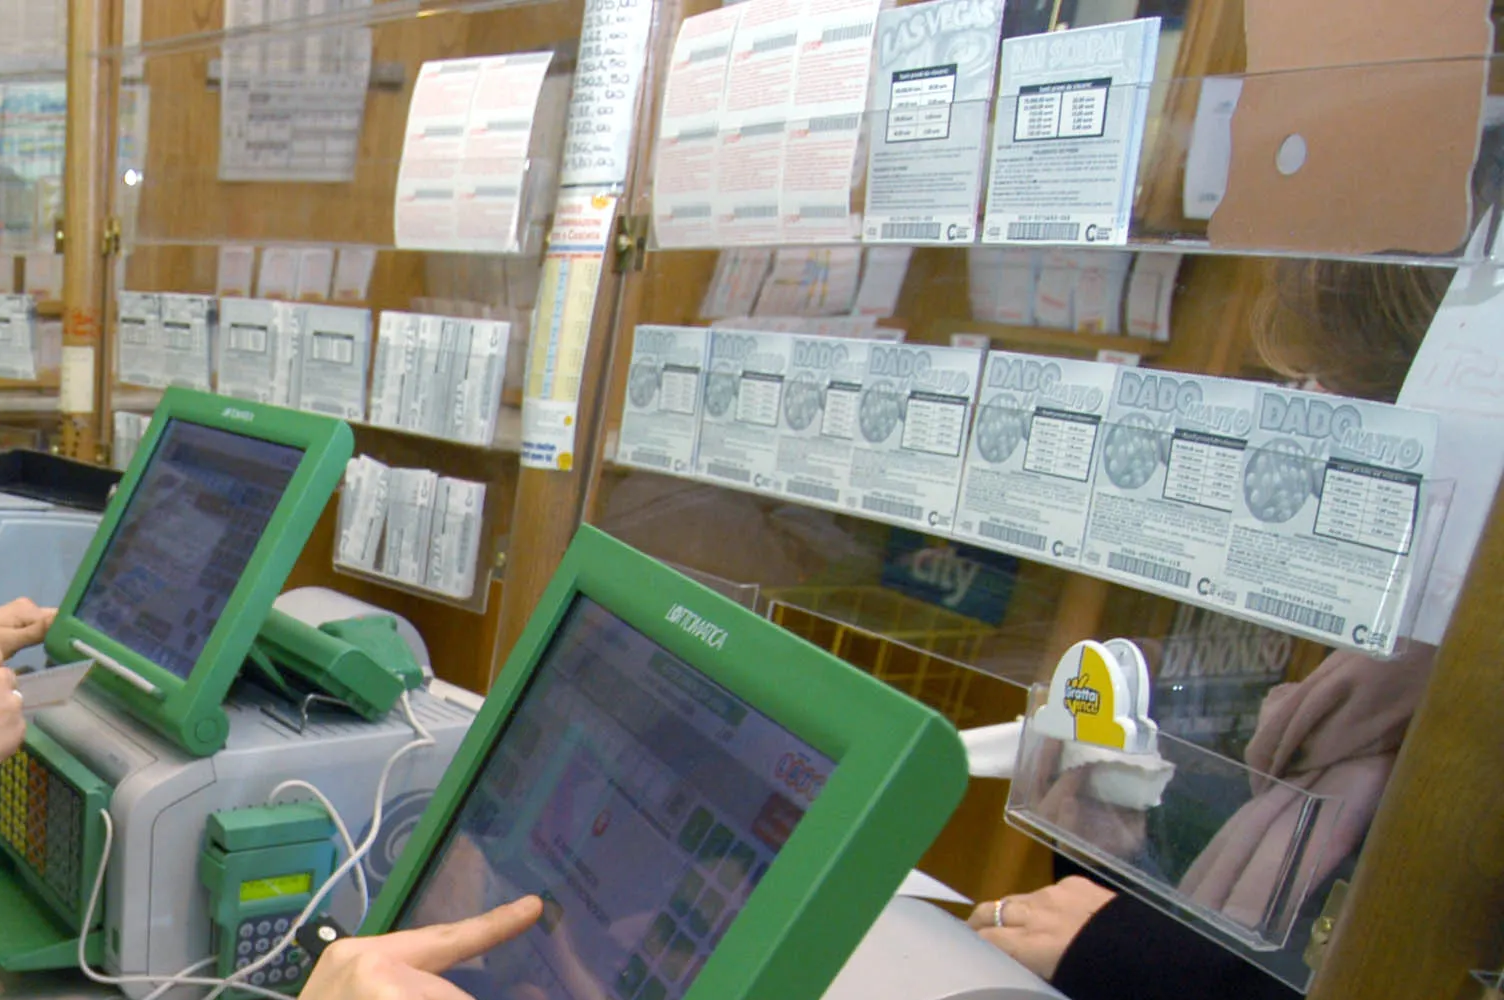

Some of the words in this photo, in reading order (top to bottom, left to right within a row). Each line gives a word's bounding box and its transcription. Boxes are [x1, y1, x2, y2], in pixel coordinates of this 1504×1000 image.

[870, 344, 932, 379] DADO
[987, 356, 1062, 395] DADO
[1046, 382, 1103, 412] MATTO
[1116, 371, 1203, 414] DADO
[1185, 402, 1253, 437] MATTO
[1259, 392, 1363, 442] DADO
[1338, 427, 1424, 469] MATTO
